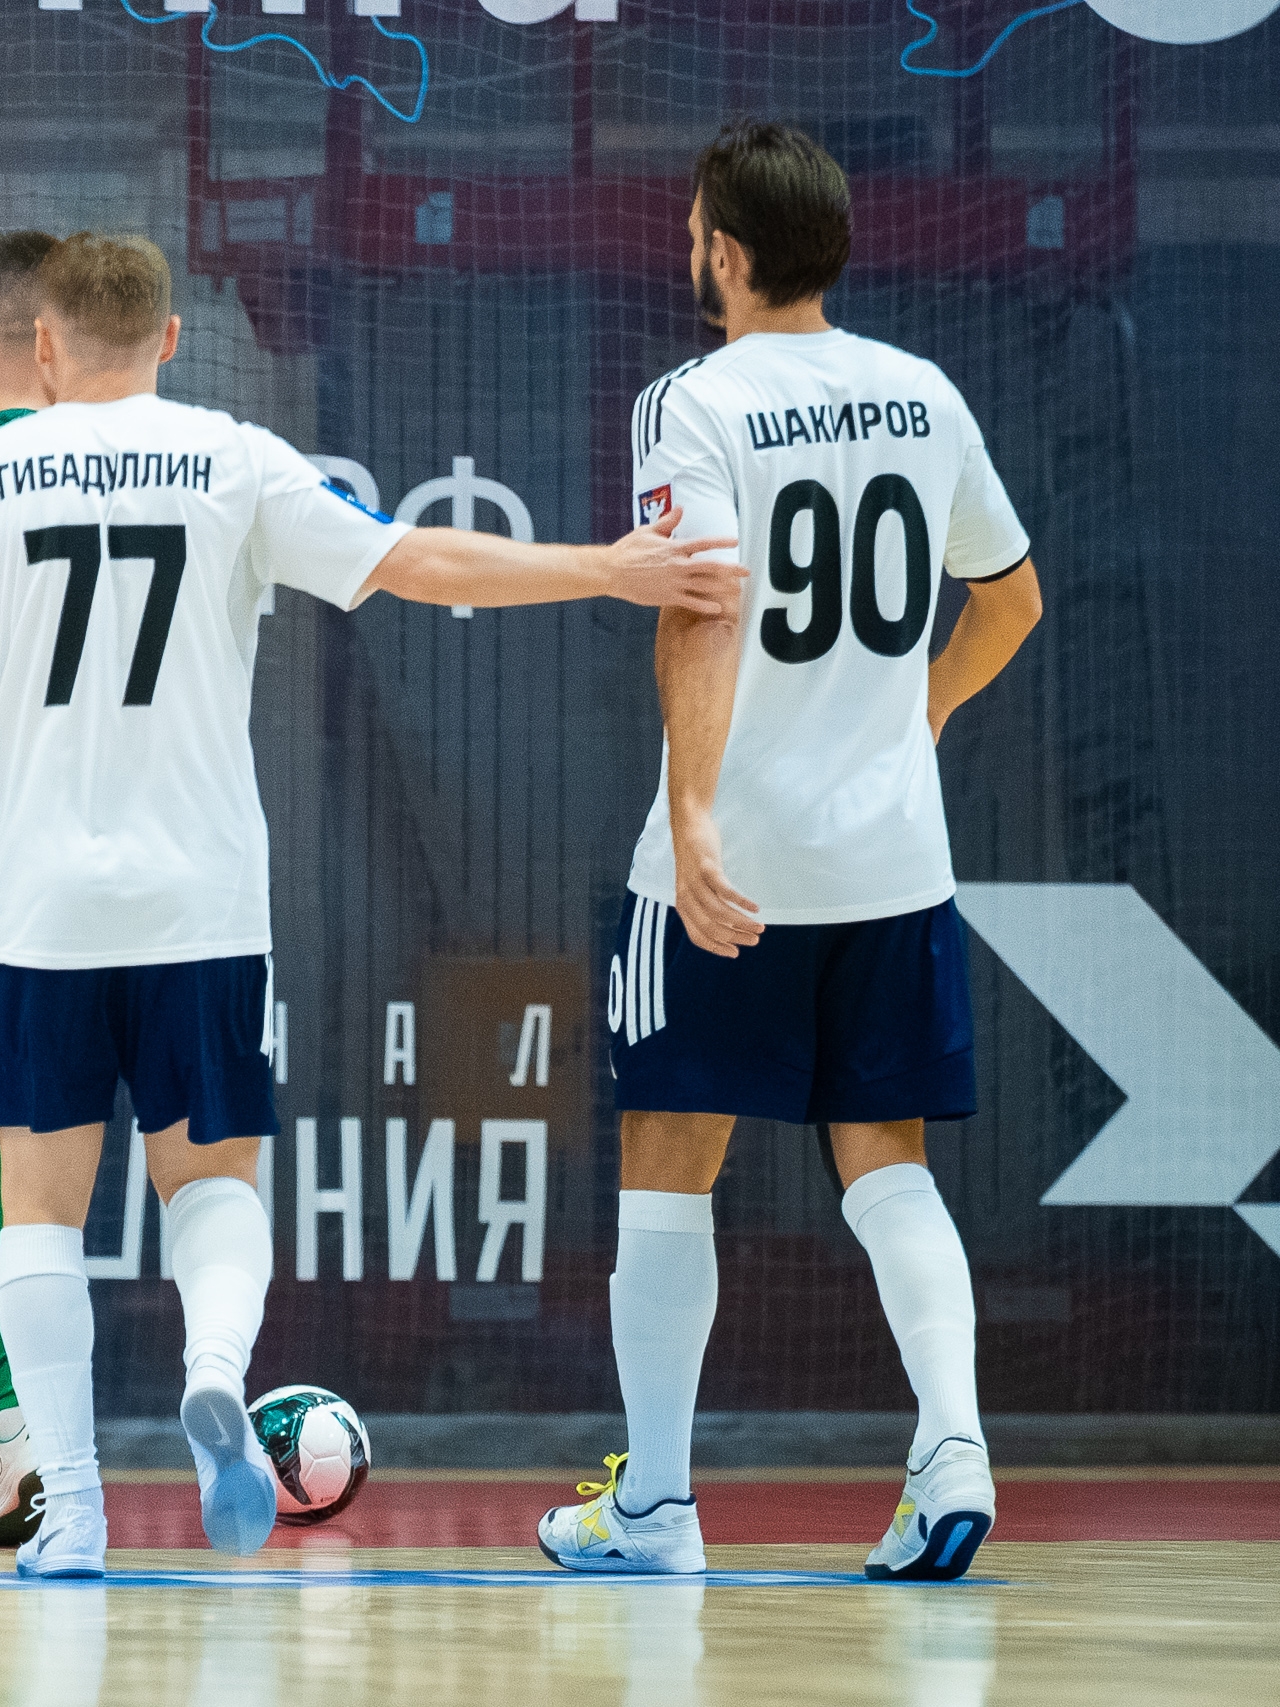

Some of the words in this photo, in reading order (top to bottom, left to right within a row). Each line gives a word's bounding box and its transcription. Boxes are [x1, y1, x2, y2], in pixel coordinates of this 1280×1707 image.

[746, 400, 930, 450] ШАКИРОВ
[23, 523, 187, 707] 77
[760, 473, 931, 664] 90
